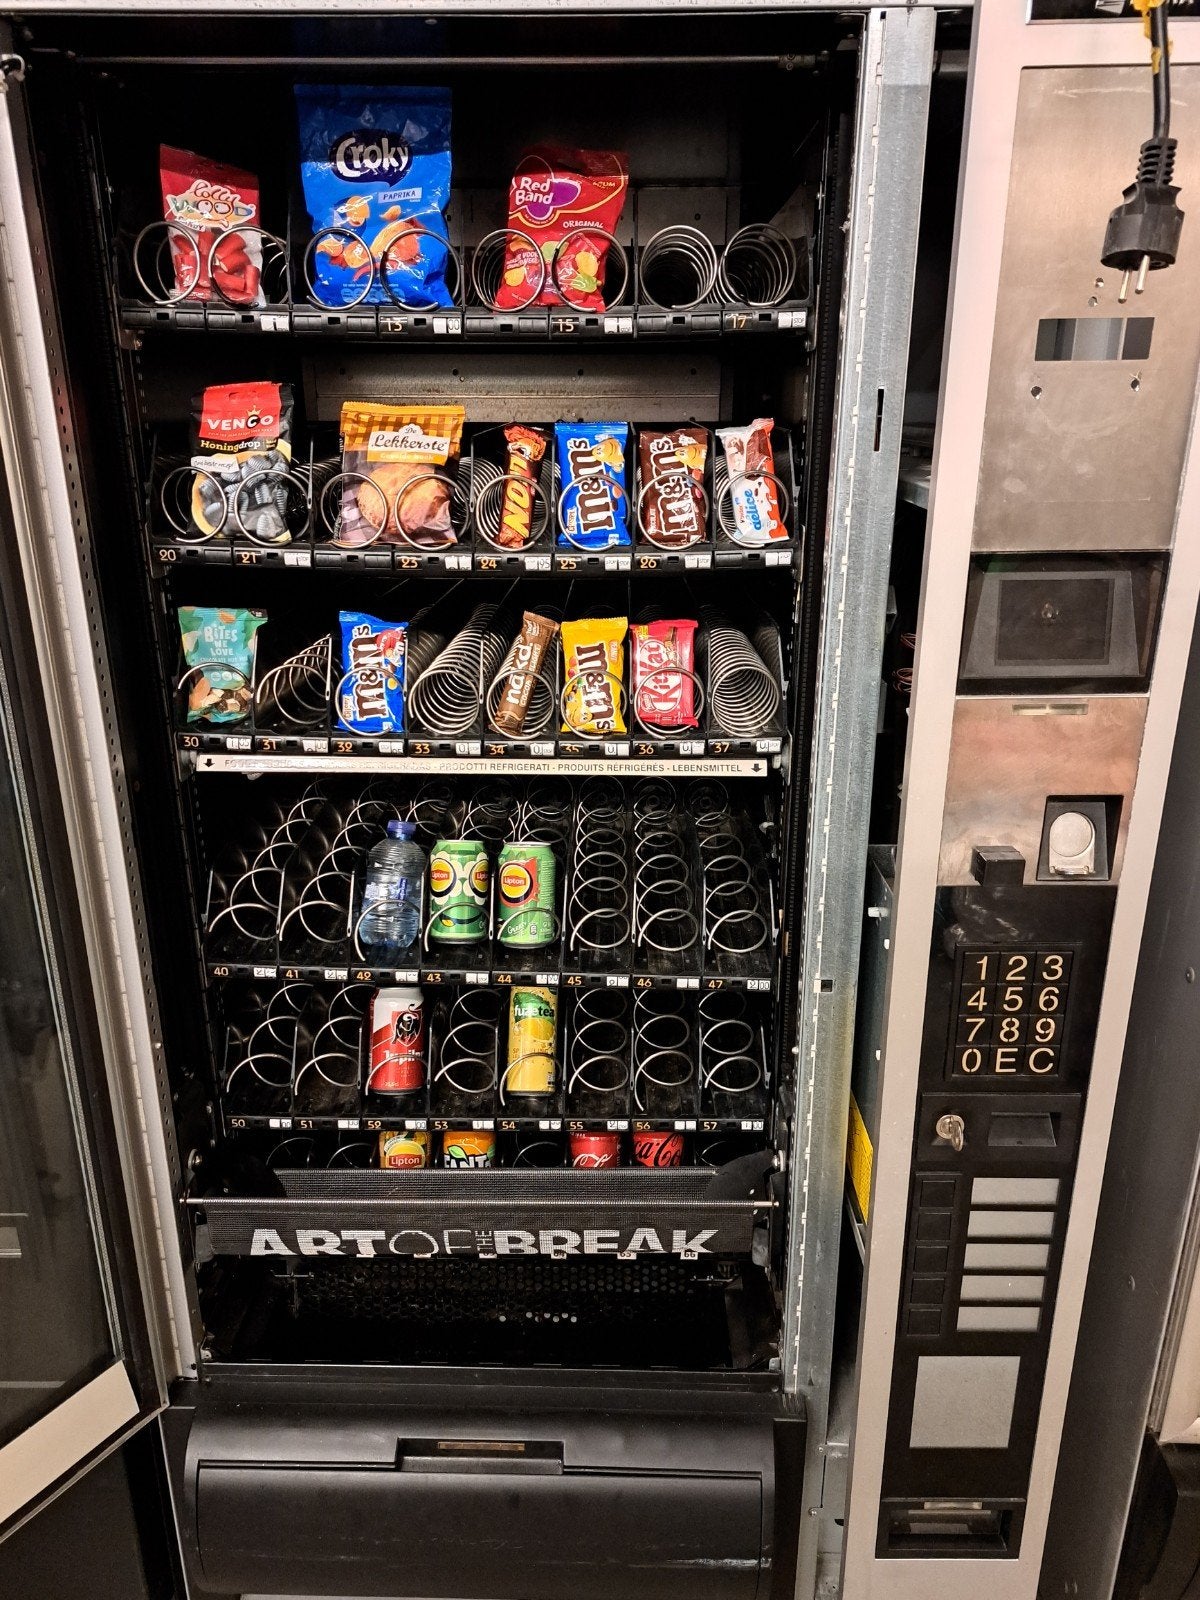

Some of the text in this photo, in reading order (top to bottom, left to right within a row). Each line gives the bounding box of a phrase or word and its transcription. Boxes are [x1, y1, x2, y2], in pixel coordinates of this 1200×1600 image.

[336, 137, 409, 177] Croky
[520, 177, 550, 192] Red
[382, 190, 417, 201] PAPRIKA
[515, 189, 553, 206] Band
[562, 220, 604, 229] ORIGINAL
[558, 318, 574, 332] 15
[731, 315, 747, 329] 17
[207, 415, 274, 431] VENCO
[200, 440, 260, 453] Honingdrop
[374, 434, 447, 452] Lekkerste
[159, 549, 176, 561] 20
[241, 552, 257, 564] 21
[401, 557, 418, 568] 23
[481, 558, 497, 569] 24
[560, 558, 577, 570] 25
[640, 556, 657, 568] 26
[215, 640, 228, 648] WE
[210, 648, 234, 656] LOVE
[183, 736, 199, 747] 30
[262, 739, 277, 750] 31
[337, 741, 353, 752] 32
[414, 743, 430, 754] 33
[489, 745, 505, 755] 34
[565, 745, 580, 753] 35
[638, 743, 654, 755] 36
[714, 742, 730, 753] 37
[439, 761, 487, 771] PRODOTTI
[489, 761, 550, 772] REFRIGERATI
[558, 762, 604, 773] PRODUITS
[606, 761, 665, 773] RÉFRIGÉRÉS
[672, 763, 742, 773] LEBENSMITTEL
[504, 877, 525, 886] Lipton
[213, 967, 229, 976] 40
[976, 954, 1064, 981] 1 2 3
[285, 969, 299, 979] 41
[356, 971, 371, 980] 42
[426, 973, 441, 982] 43
[497, 974, 512, 983] 44
[567, 976, 582, 985] 45
[637, 978, 652, 987] 46
[708, 980, 723, 989] 47
[967, 986, 1060, 1011] 4 5 6
[965, 1017, 1056, 1042] 7 8 9
[961, 1047, 1055, 1073] 0 E C
[231, 1119, 246, 1127] 50
[300, 1120, 313, 1129] 51
[367, 1121, 382, 1129] 52
[434, 1121, 449, 1129] 53
[502, 1121, 516, 1130] 54
[569, 1121, 584, 1130] 55
[636, 1121, 651, 1130] 56
[703, 1121, 717, 1130] 57
[391, 1156, 420, 1165] Lipton
[250, 1227, 719, 1256] ART OF THE BREAK
